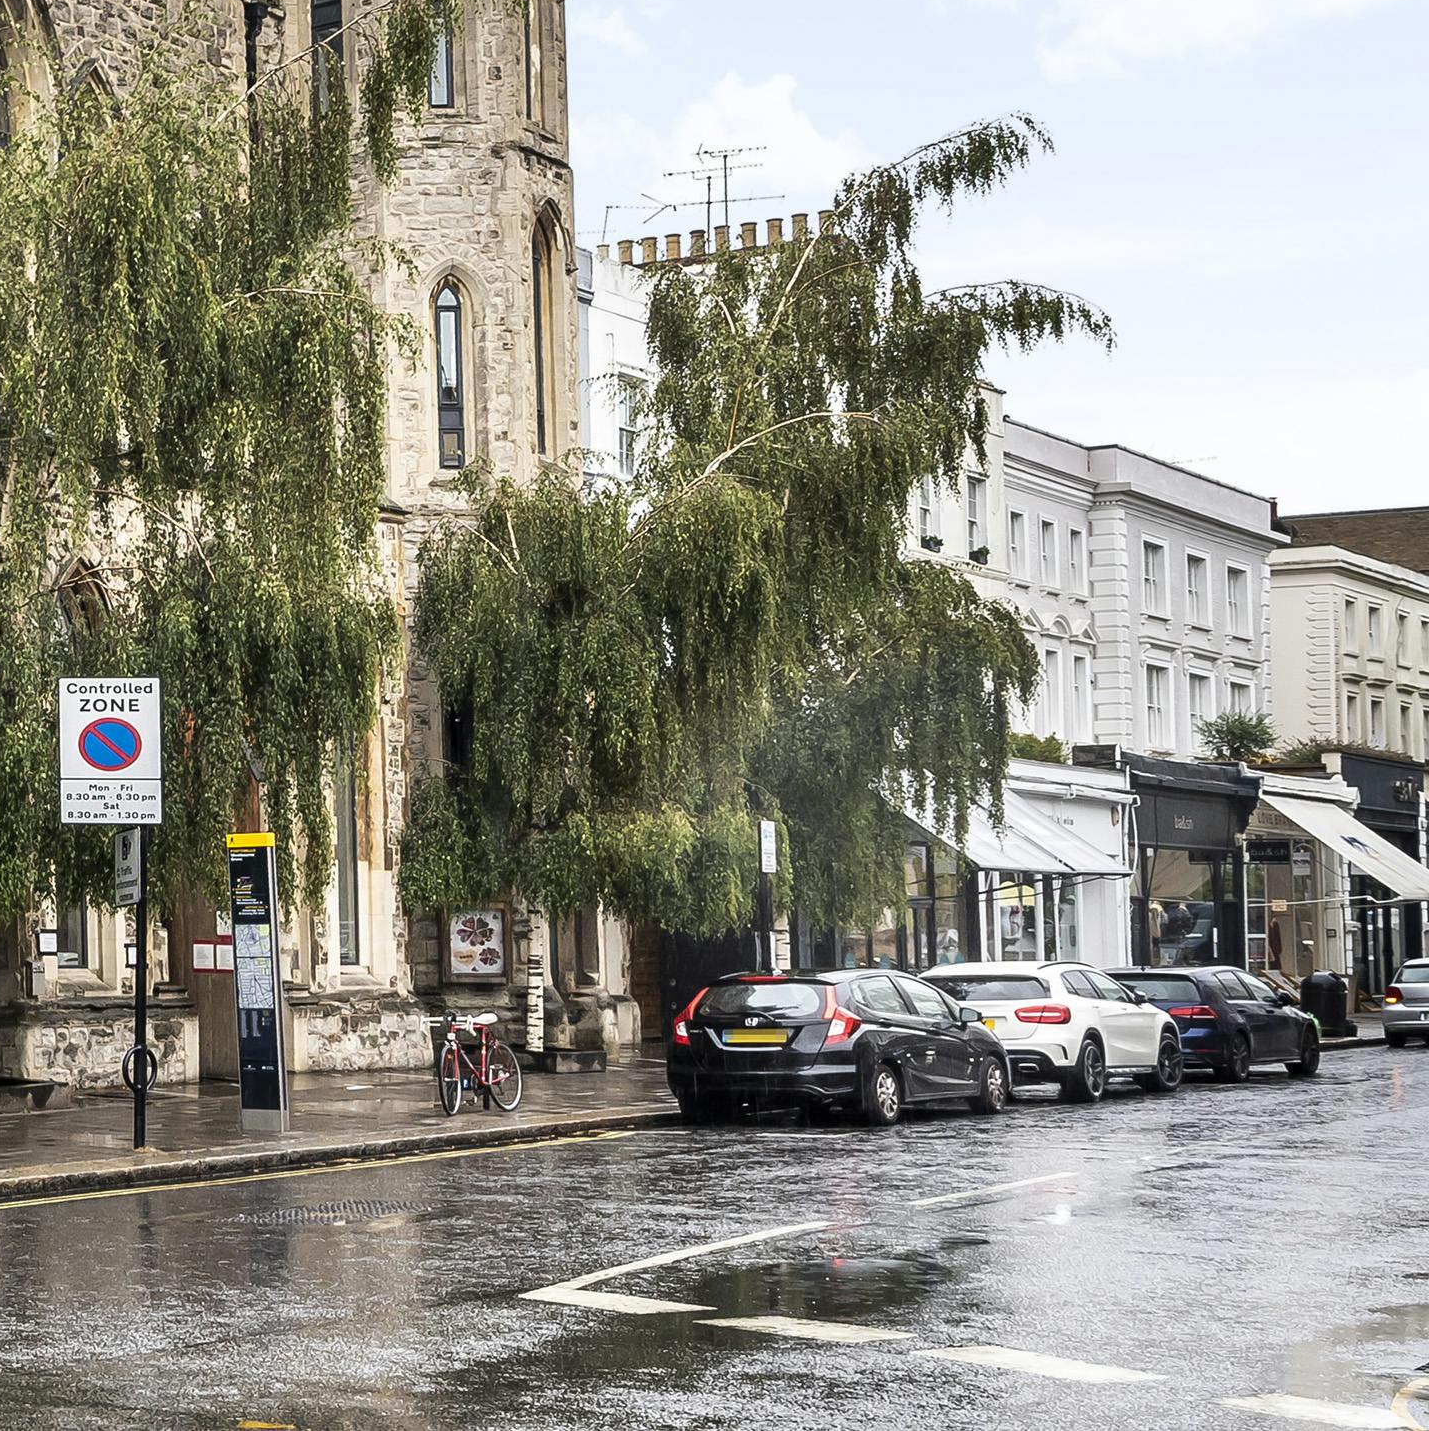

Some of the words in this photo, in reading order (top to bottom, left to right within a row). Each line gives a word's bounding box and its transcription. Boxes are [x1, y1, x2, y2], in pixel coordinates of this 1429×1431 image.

[66, 683, 153, 694] Controlled
[79, 699, 140, 712] ZONE
[116, 793, 140, 801] 6.30
[103, 802, 120, 810] Sat
[67, 811, 91, 819] 8.30
[118, 811, 139, 819] 1.30
